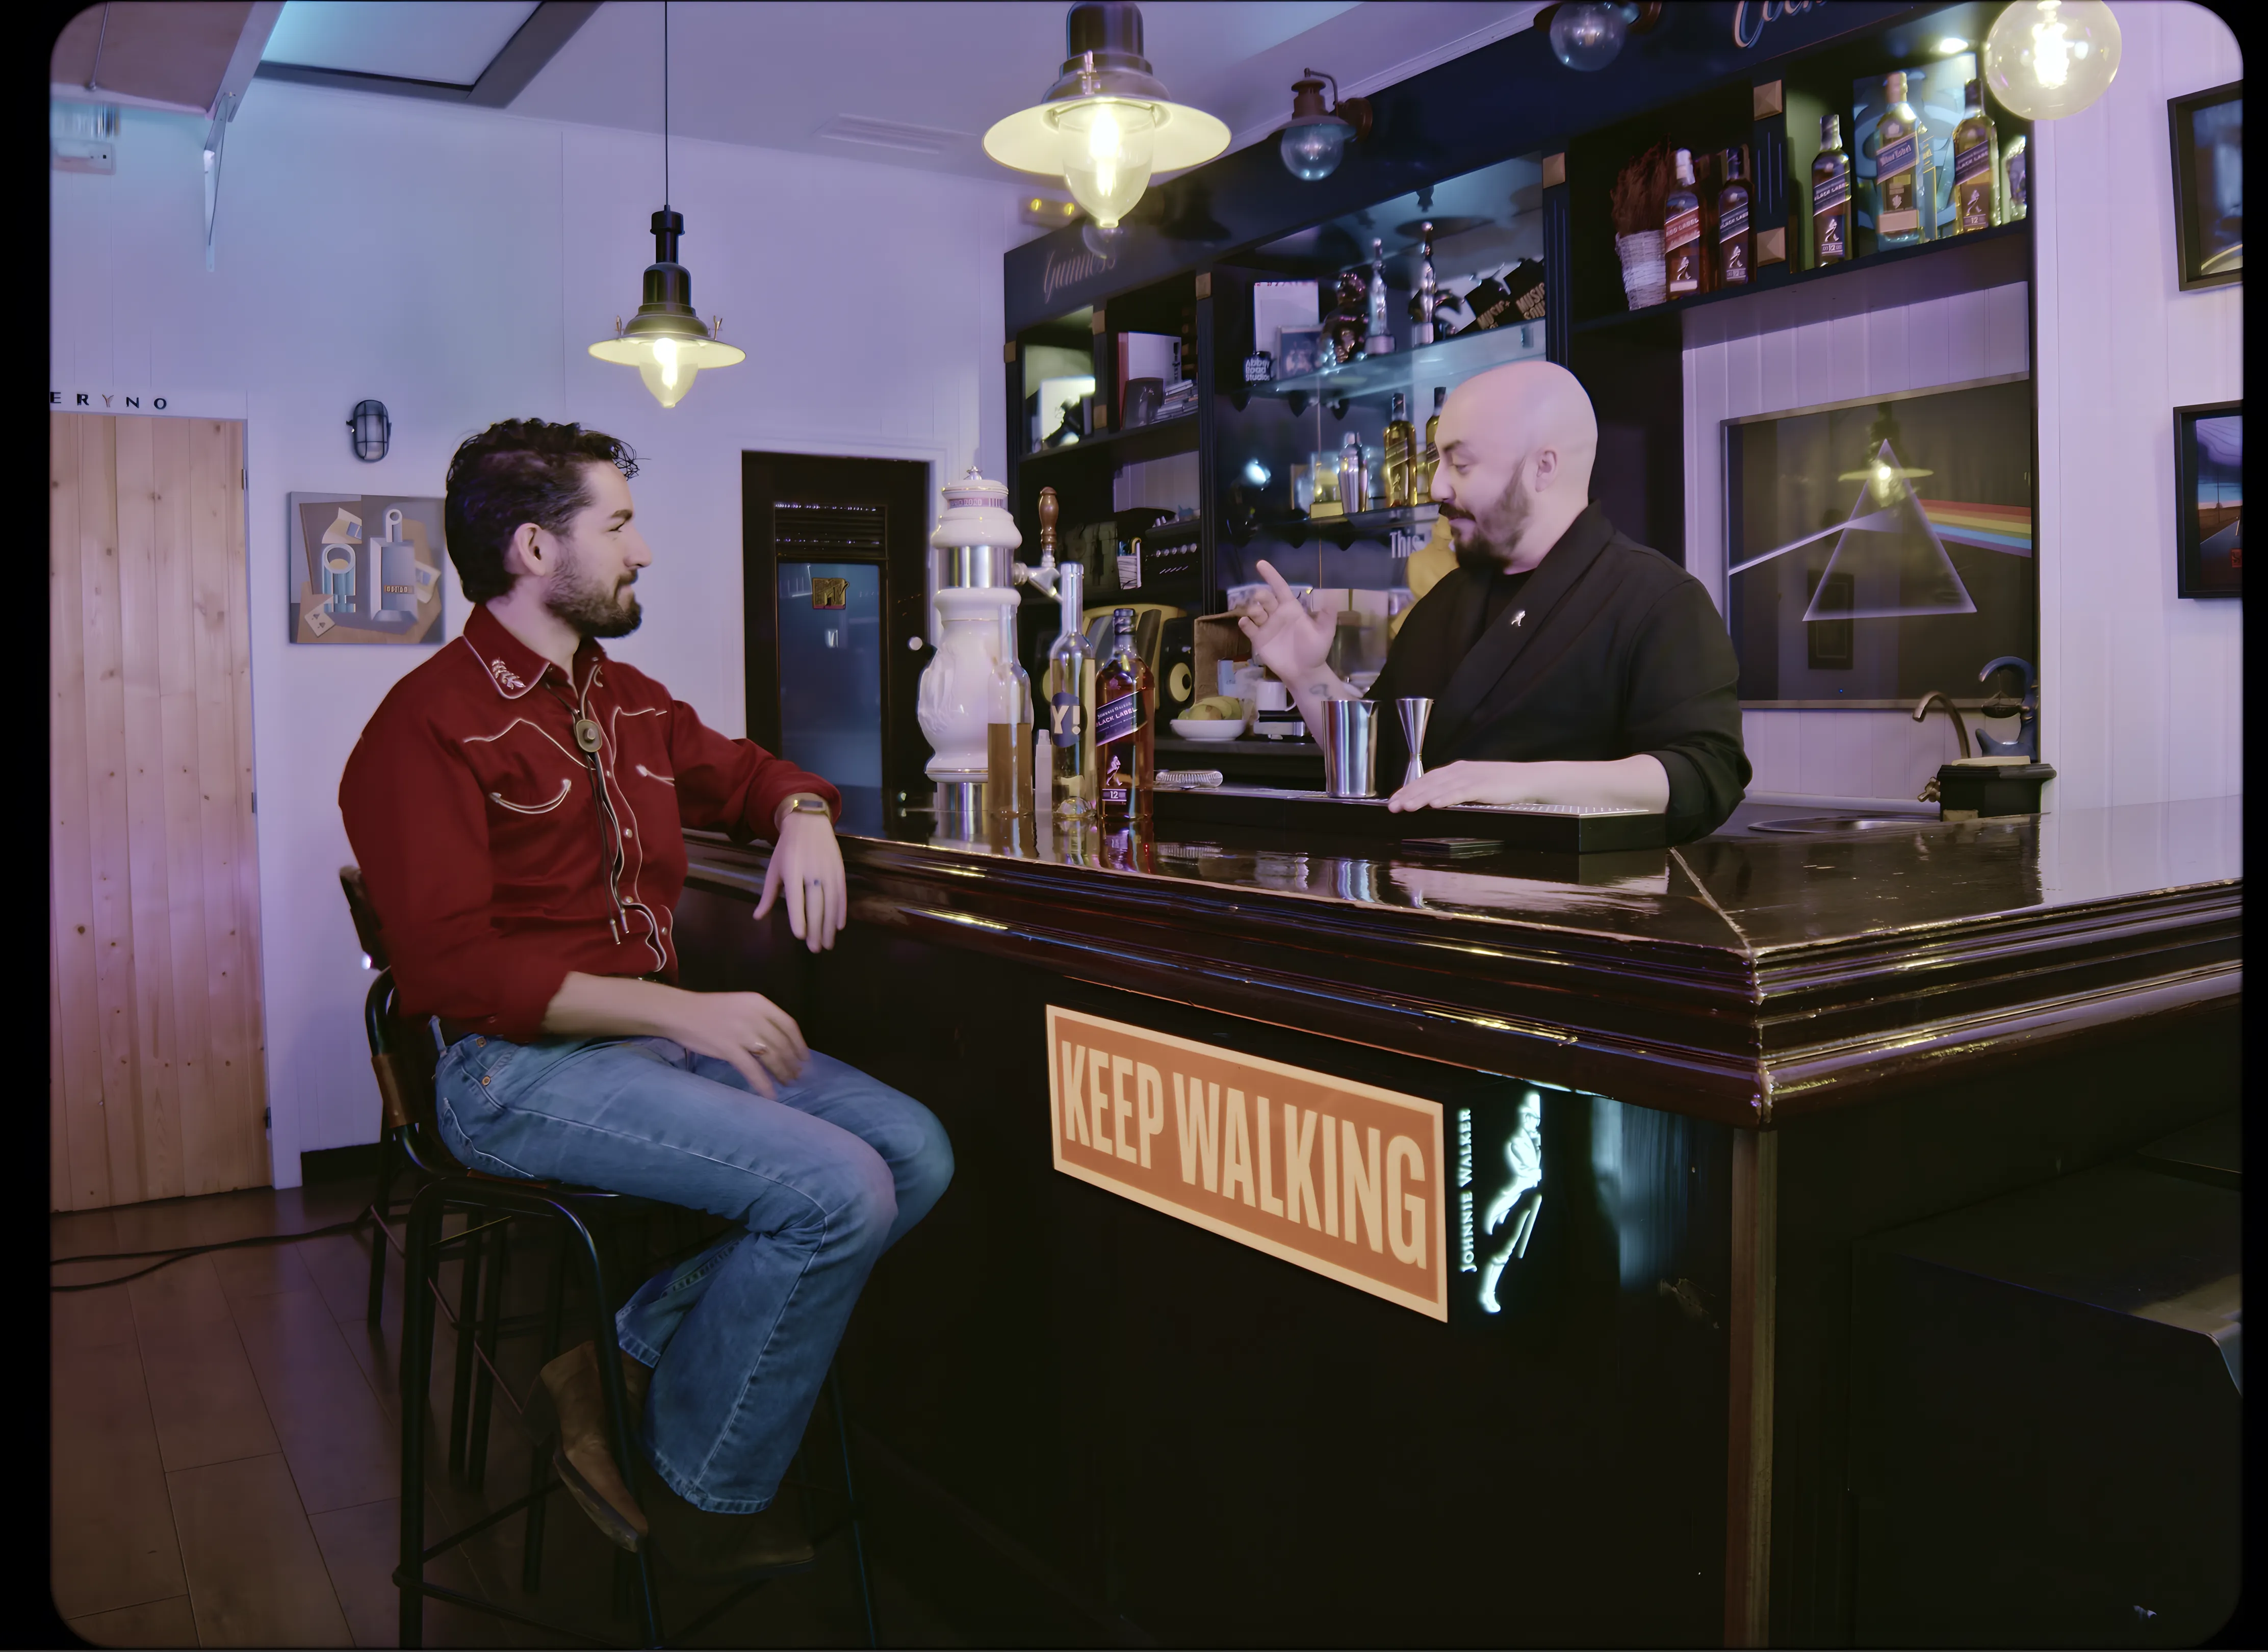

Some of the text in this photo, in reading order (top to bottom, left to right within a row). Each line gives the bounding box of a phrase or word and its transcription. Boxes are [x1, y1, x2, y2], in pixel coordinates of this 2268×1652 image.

[1051, 705, 1081, 735] Y!
[1110, 791, 1118, 799] 12
[1062, 1040, 1427, 1271] KEEP WALKING
[1457, 1107, 1478, 1273] JOHNNIE WALKER
